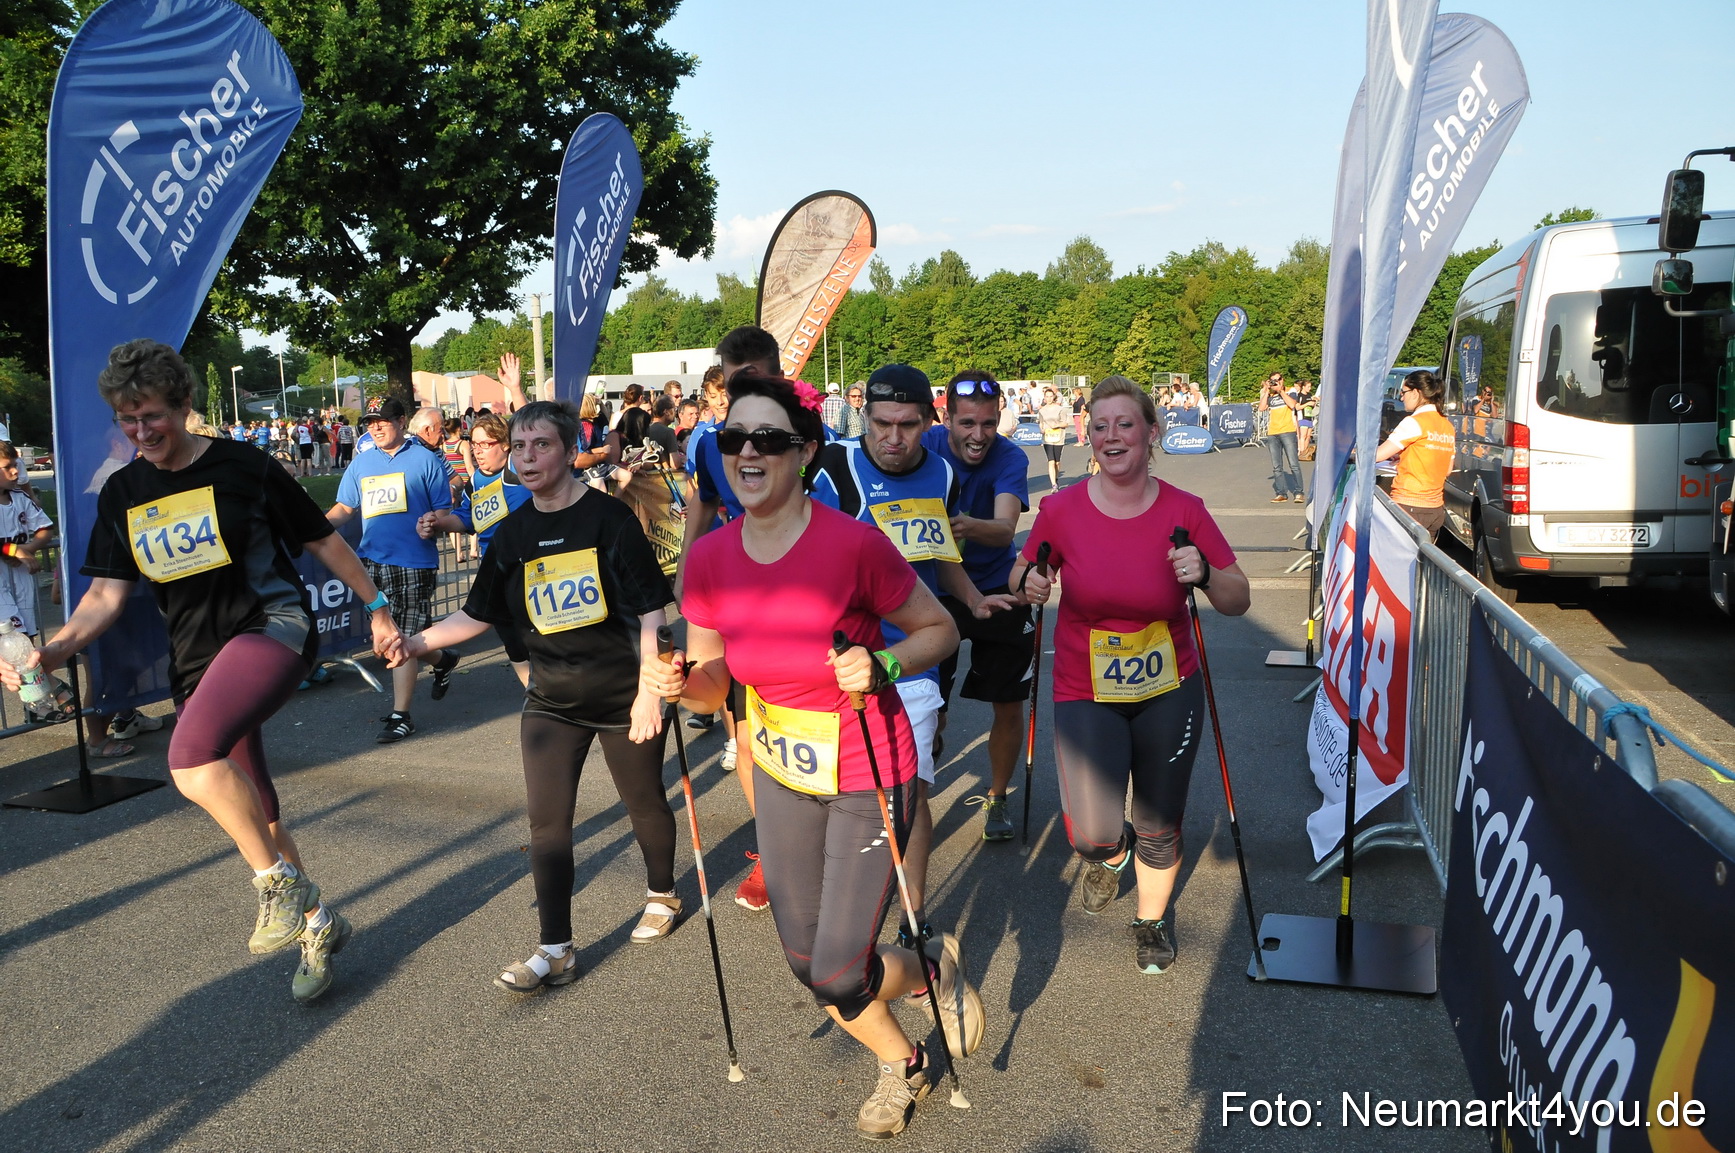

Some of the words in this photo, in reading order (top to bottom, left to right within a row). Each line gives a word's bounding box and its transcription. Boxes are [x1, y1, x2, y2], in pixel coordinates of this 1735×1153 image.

[116, 49, 252, 266] Fischer
[1400, 60, 1488, 253] ischer
[1419, 98, 1501, 252] AUTOMOBILE
[168, 96, 269, 267] AUTOMOBILE
[579, 152, 625, 299] Fischer
[592, 182, 631, 298] AUTOMOBILE
[784, 241, 862, 377] CHSELSZENE.DE
[1210, 326, 1237, 367] Frischmann
[1174, 437, 1207, 446] Fischer
[1224, 419, 1247, 429] Fischer
[368, 487, 398, 506] 720
[474, 495, 500, 521] 628
[135, 515, 217, 564] 1134
[891, 518, 945, 545] 728
[1610, 528, 1647, 542] 3272
[163, 560, 176, 568] Erika
[299, 574, 354, 611] her
[528, 575, 600, 616] 1126
[562, 608, 585, 617] Schneider
[317, 611, 351, 634] BILE
[1103, 651, 1163, 684] 420
[755, 726, 818, 775] 419
[1455, 718, 1636, 1153] ischmann
